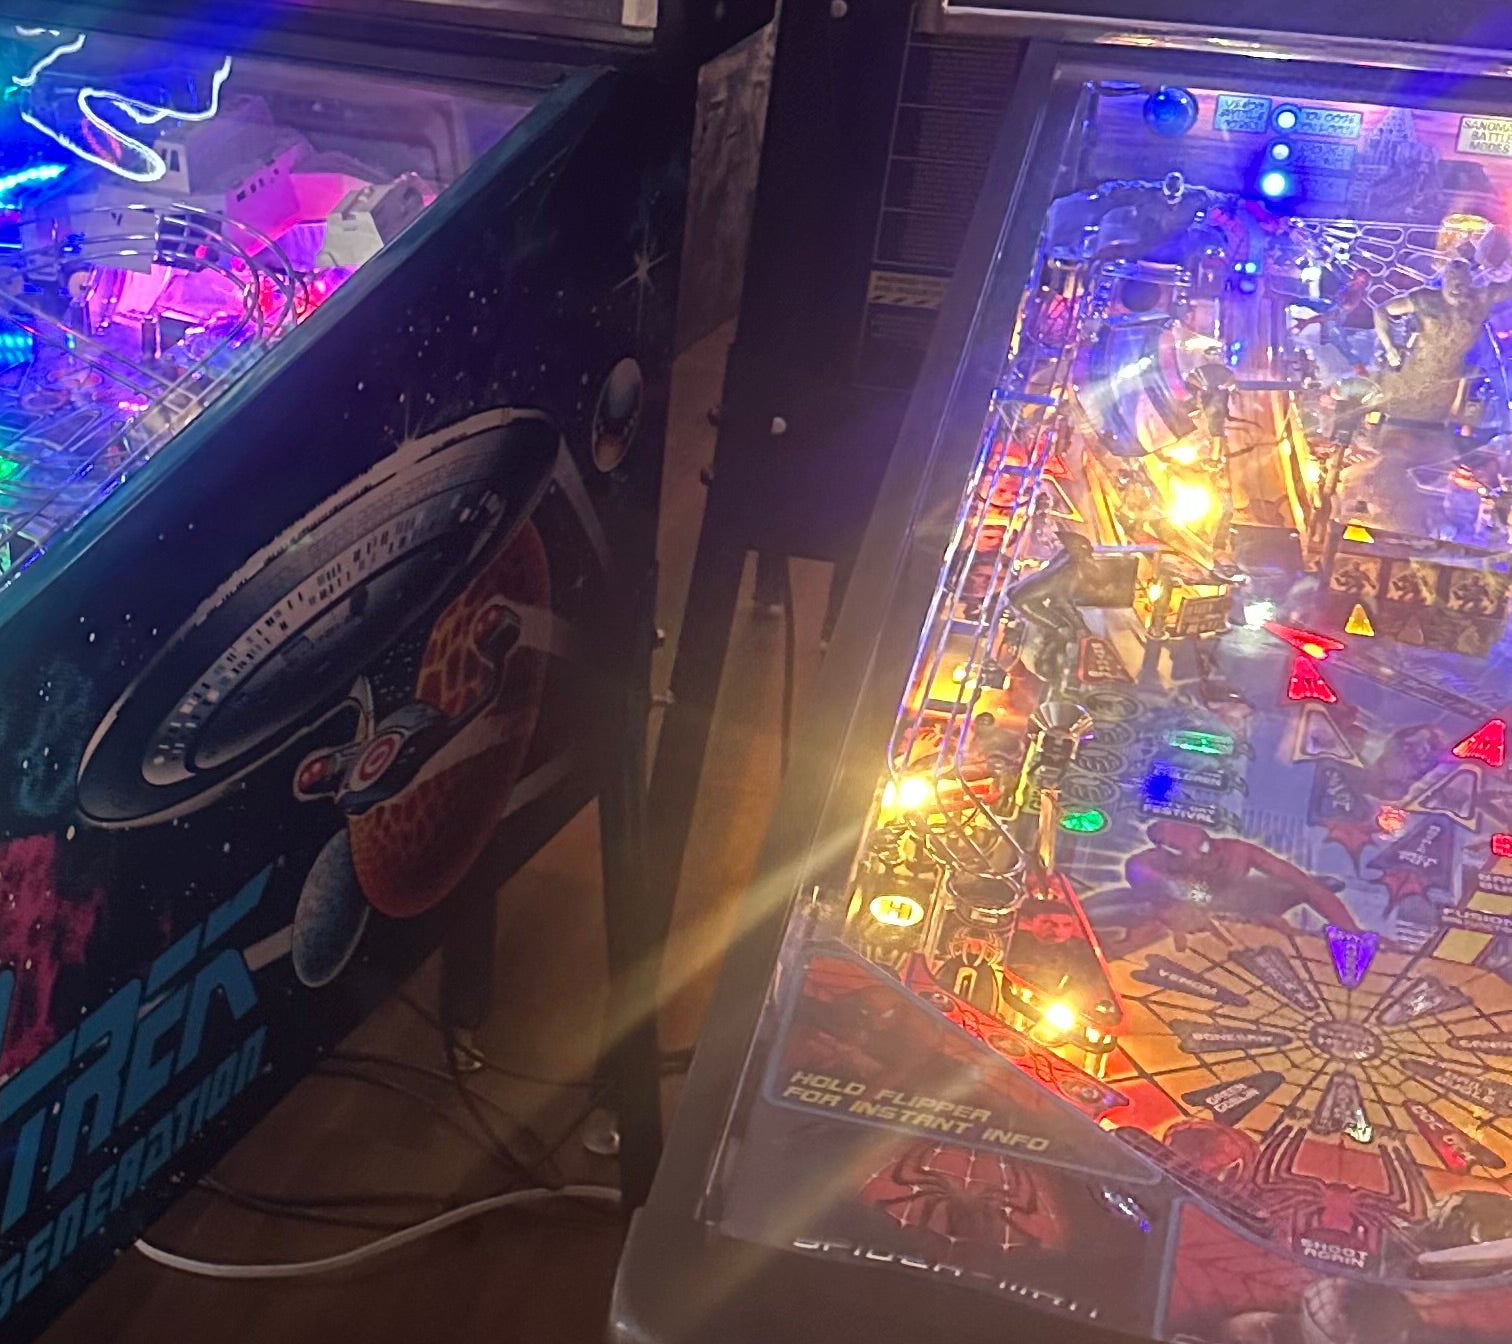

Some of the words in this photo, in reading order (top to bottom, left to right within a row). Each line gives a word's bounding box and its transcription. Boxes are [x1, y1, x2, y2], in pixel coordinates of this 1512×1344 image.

[1158, 968, 1219, 996] VENOM
[790, 1070, 866, 1097] HOLD
[874, 1088, 992, 1123] FLIPPER
[782, 1085, 843, 1109] FOR
[848, 1099, 972, 1136] INSTANT
[981, 1127, 1050, 1153] INFO
[1300, 1237, 1369, 1260] SHOOT
[1303, 1247, 1365, 1269] AGAIN
